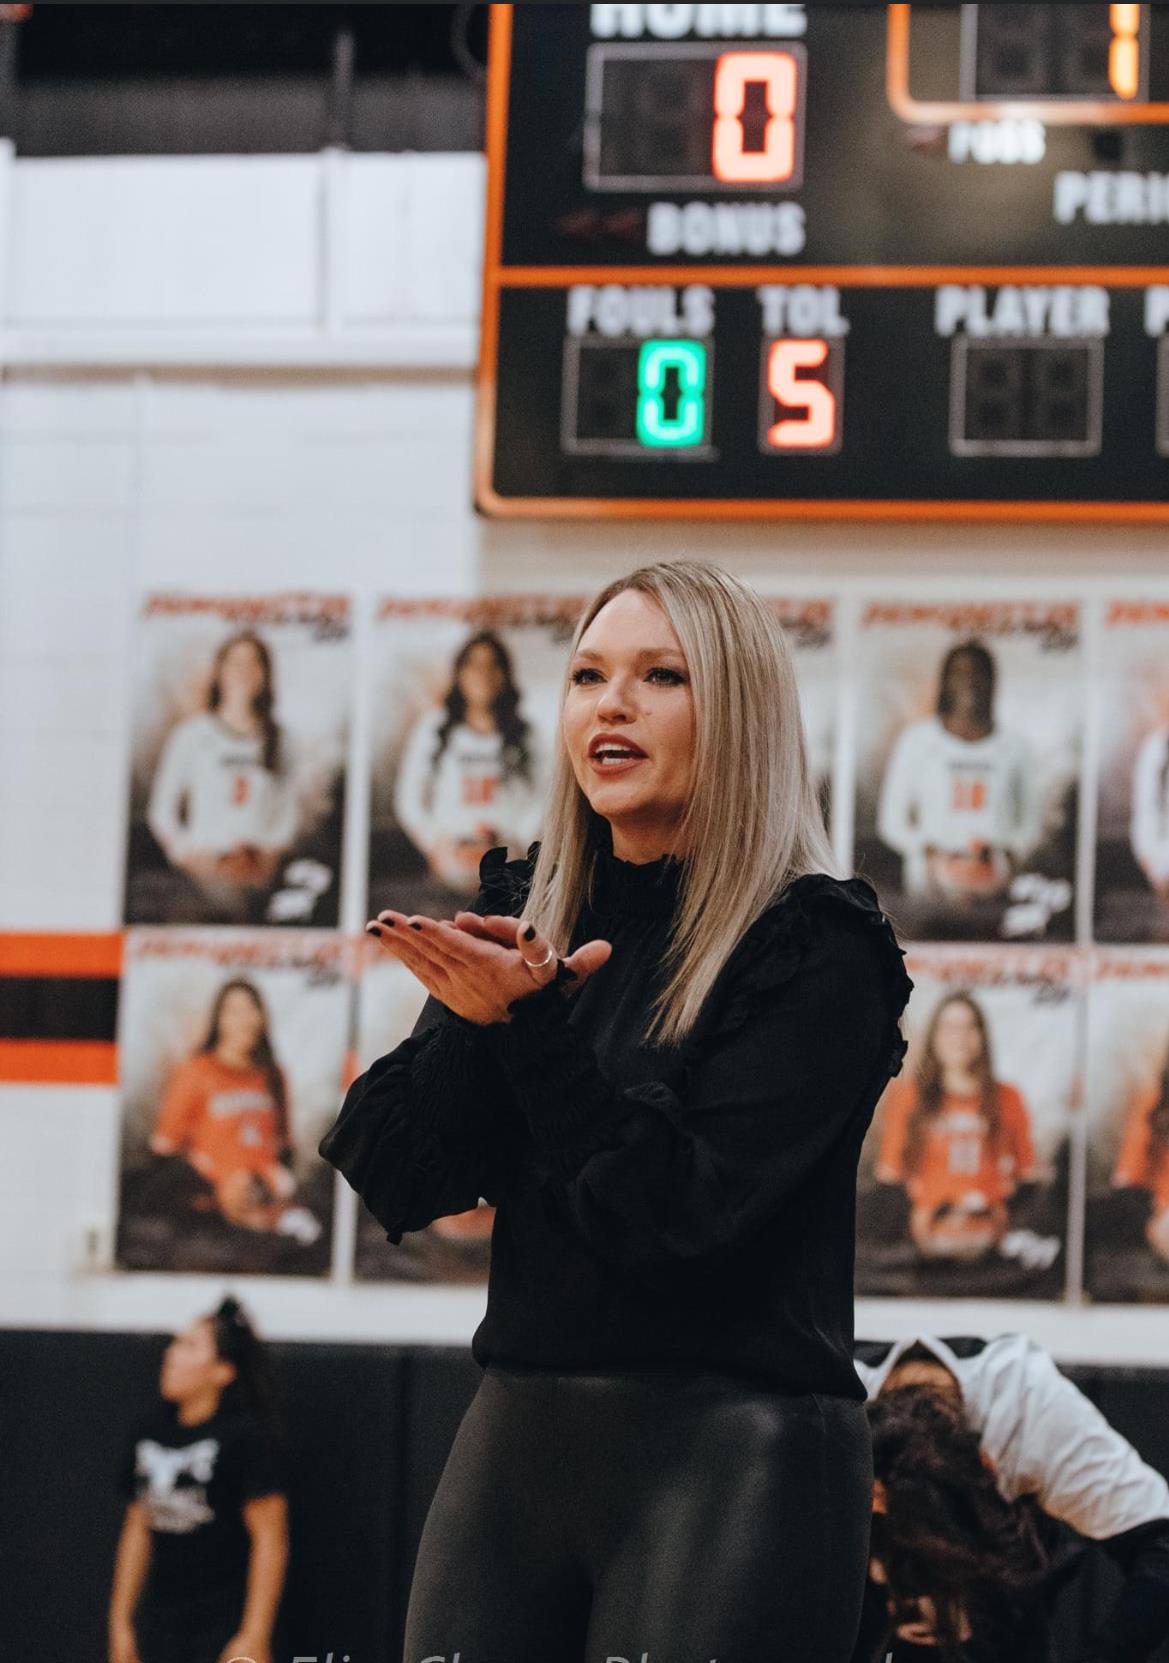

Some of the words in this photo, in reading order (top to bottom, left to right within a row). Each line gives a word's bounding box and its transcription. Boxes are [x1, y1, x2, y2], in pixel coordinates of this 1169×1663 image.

[713, 51, 798, 183] 0
[1054, 171, 1169, 225] PERI
[648, 201, 807, 256] BONUS
[567, 286, 715, 336] FOULS
[935, 286, 1110, 337] PLAYER
[636, 339, 706, 448] 0
[767, 339, 836, 449] 5
